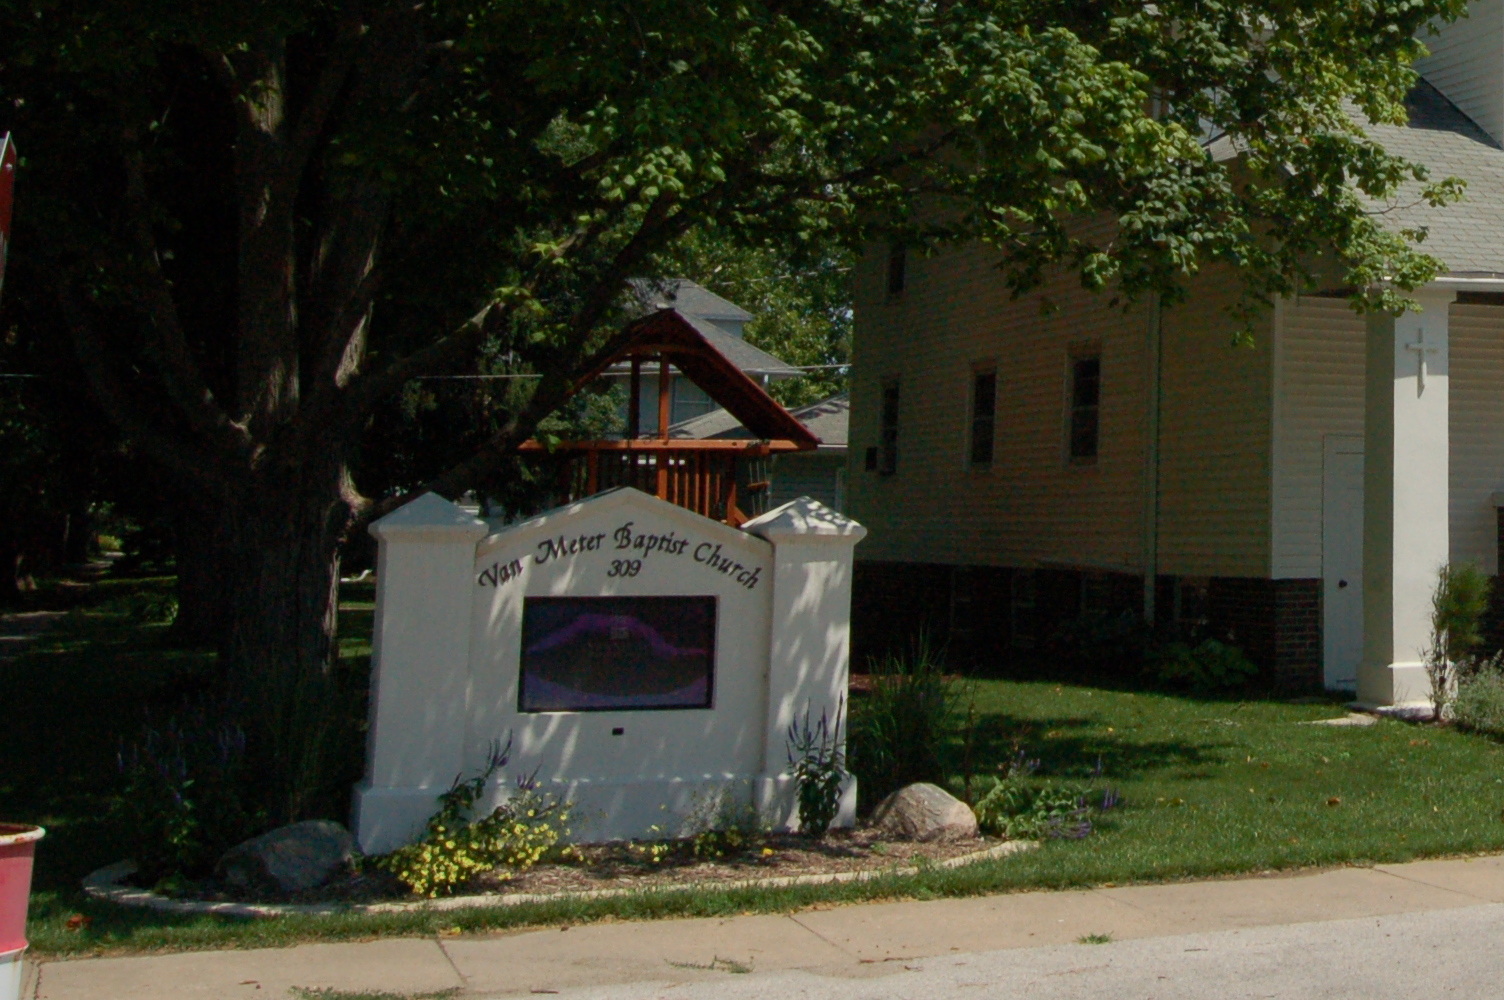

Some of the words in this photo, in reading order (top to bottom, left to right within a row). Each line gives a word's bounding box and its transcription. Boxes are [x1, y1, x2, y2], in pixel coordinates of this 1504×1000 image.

[478, 559, 523, 588] Van
[534, 533, 606, 564] Meter
[613, 521, 689, 557] Baptist
[693, 542, 763, 589] Church
[607, 559, 642, 577] 309
